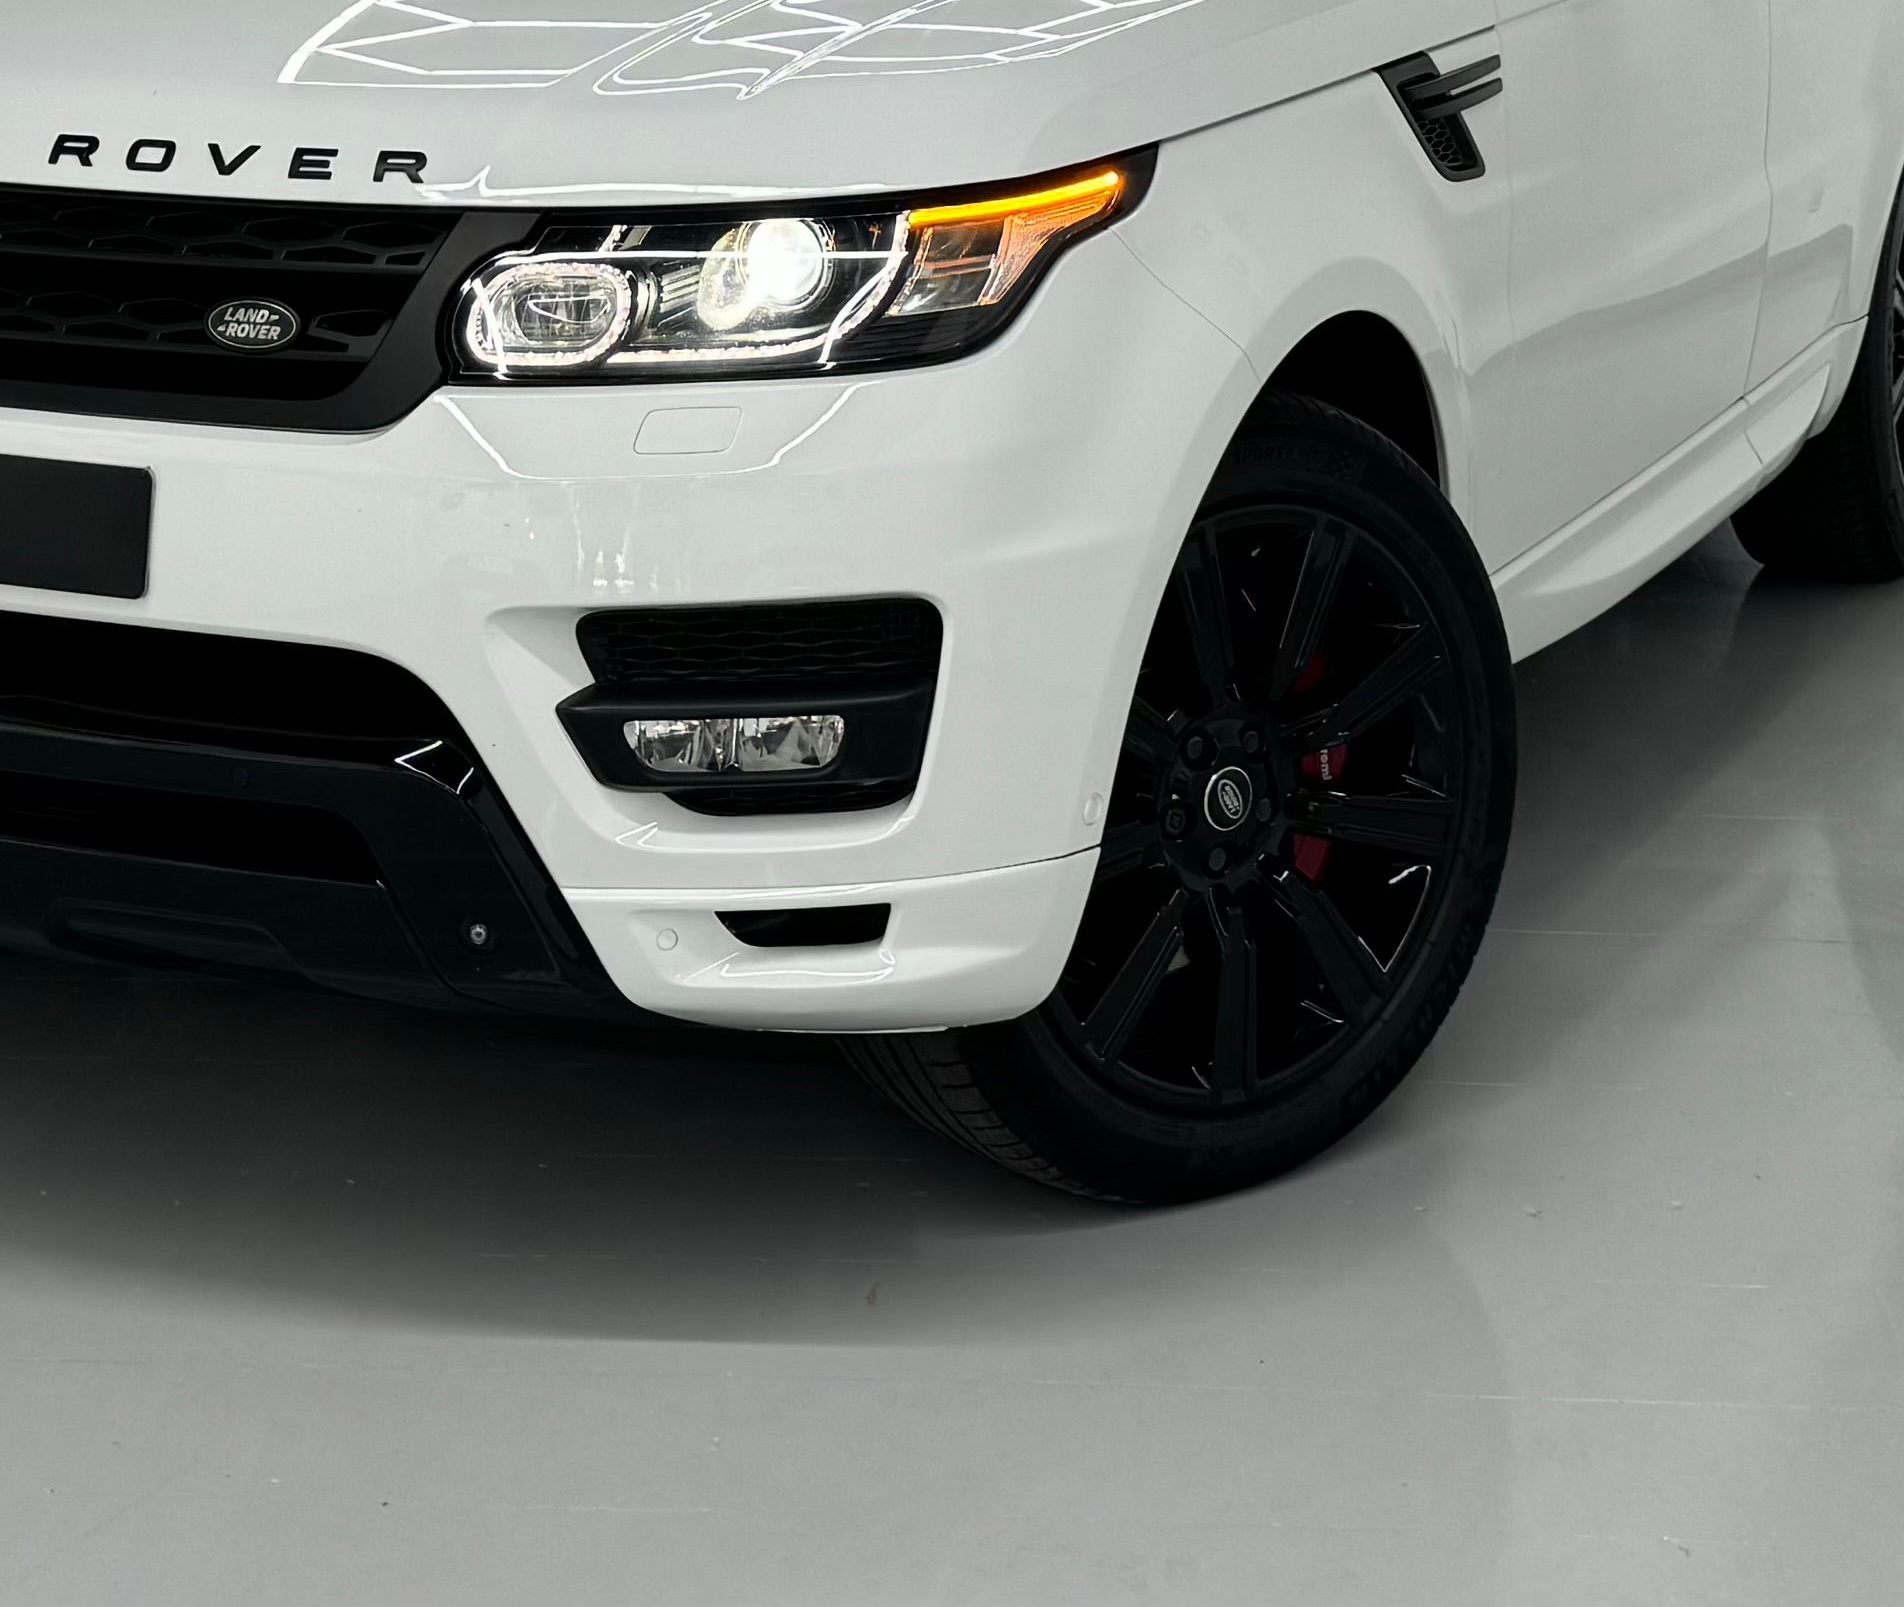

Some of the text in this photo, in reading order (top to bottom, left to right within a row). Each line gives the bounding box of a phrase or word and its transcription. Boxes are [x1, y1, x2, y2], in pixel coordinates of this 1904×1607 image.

[47, 133, 430, 184] ROVER
[224, 306, 270, 324] LAND
[225, 322, 281, 340] ROVER
